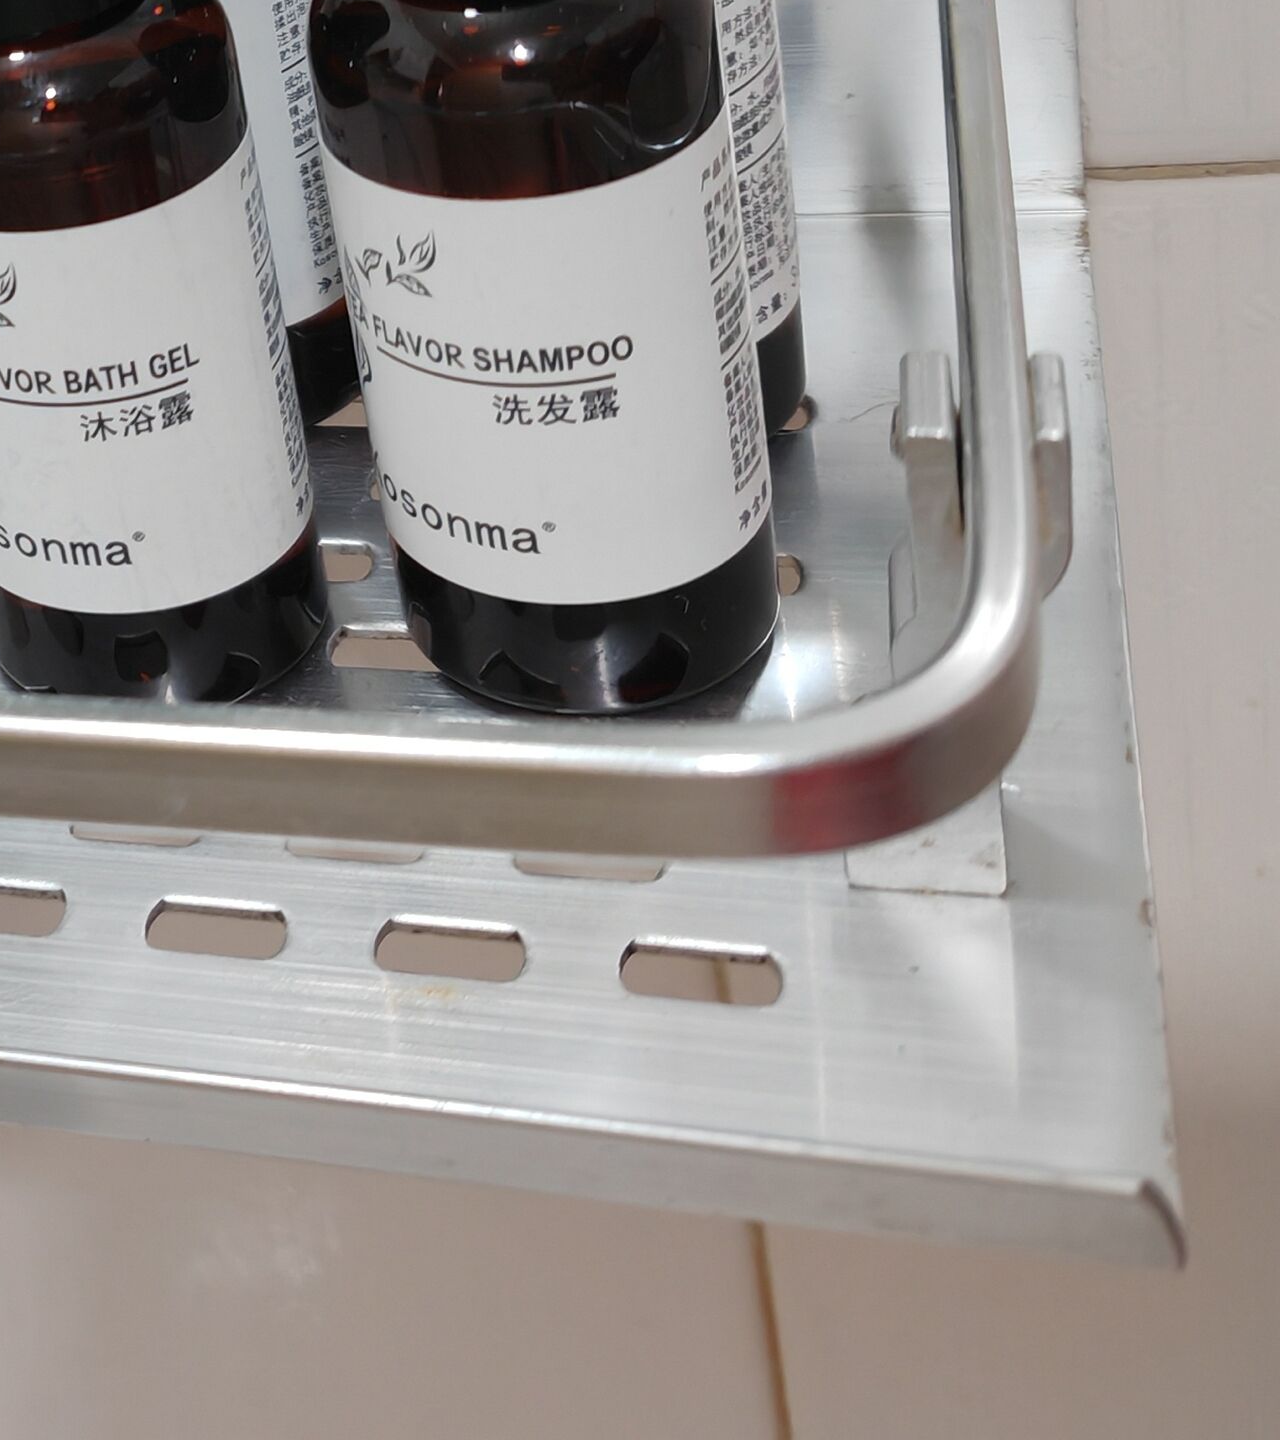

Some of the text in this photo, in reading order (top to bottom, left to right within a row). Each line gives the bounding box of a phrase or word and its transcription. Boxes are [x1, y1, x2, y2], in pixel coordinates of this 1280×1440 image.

[63, 361, 139, 394] BATH
[149, 343, 200, 379] GEL
[372, 314, 465, 369] FLAVOR
[473, 335, 633, 373] SHAMPOO
[80, 390, 193, 442] 沐浴露
[492, 386, 620, 426] 洗发露
